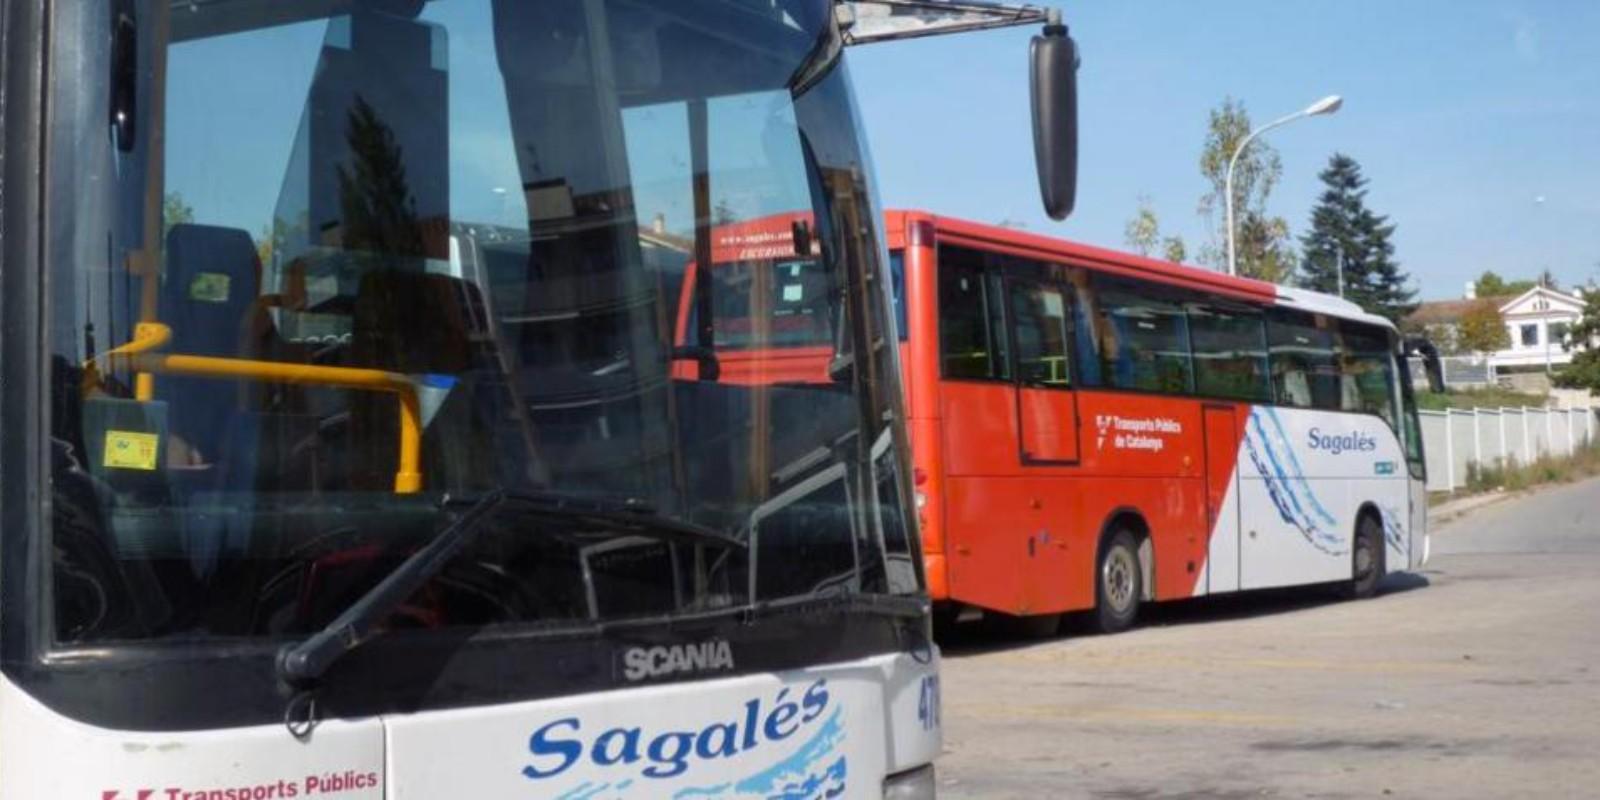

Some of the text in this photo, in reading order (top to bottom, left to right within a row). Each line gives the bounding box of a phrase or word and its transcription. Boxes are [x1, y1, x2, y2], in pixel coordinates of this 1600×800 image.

[1114, 416, 1154, 434] Transports
[1115, 434, 1163, 452] de Catalunya
[1307, 427, 1377, 455] Sagalés
[624, 641, 734, 681] SCANIA
[522, 678, 830, 779] Sagalés
[164, 769, 378, 800] Transports Públics
